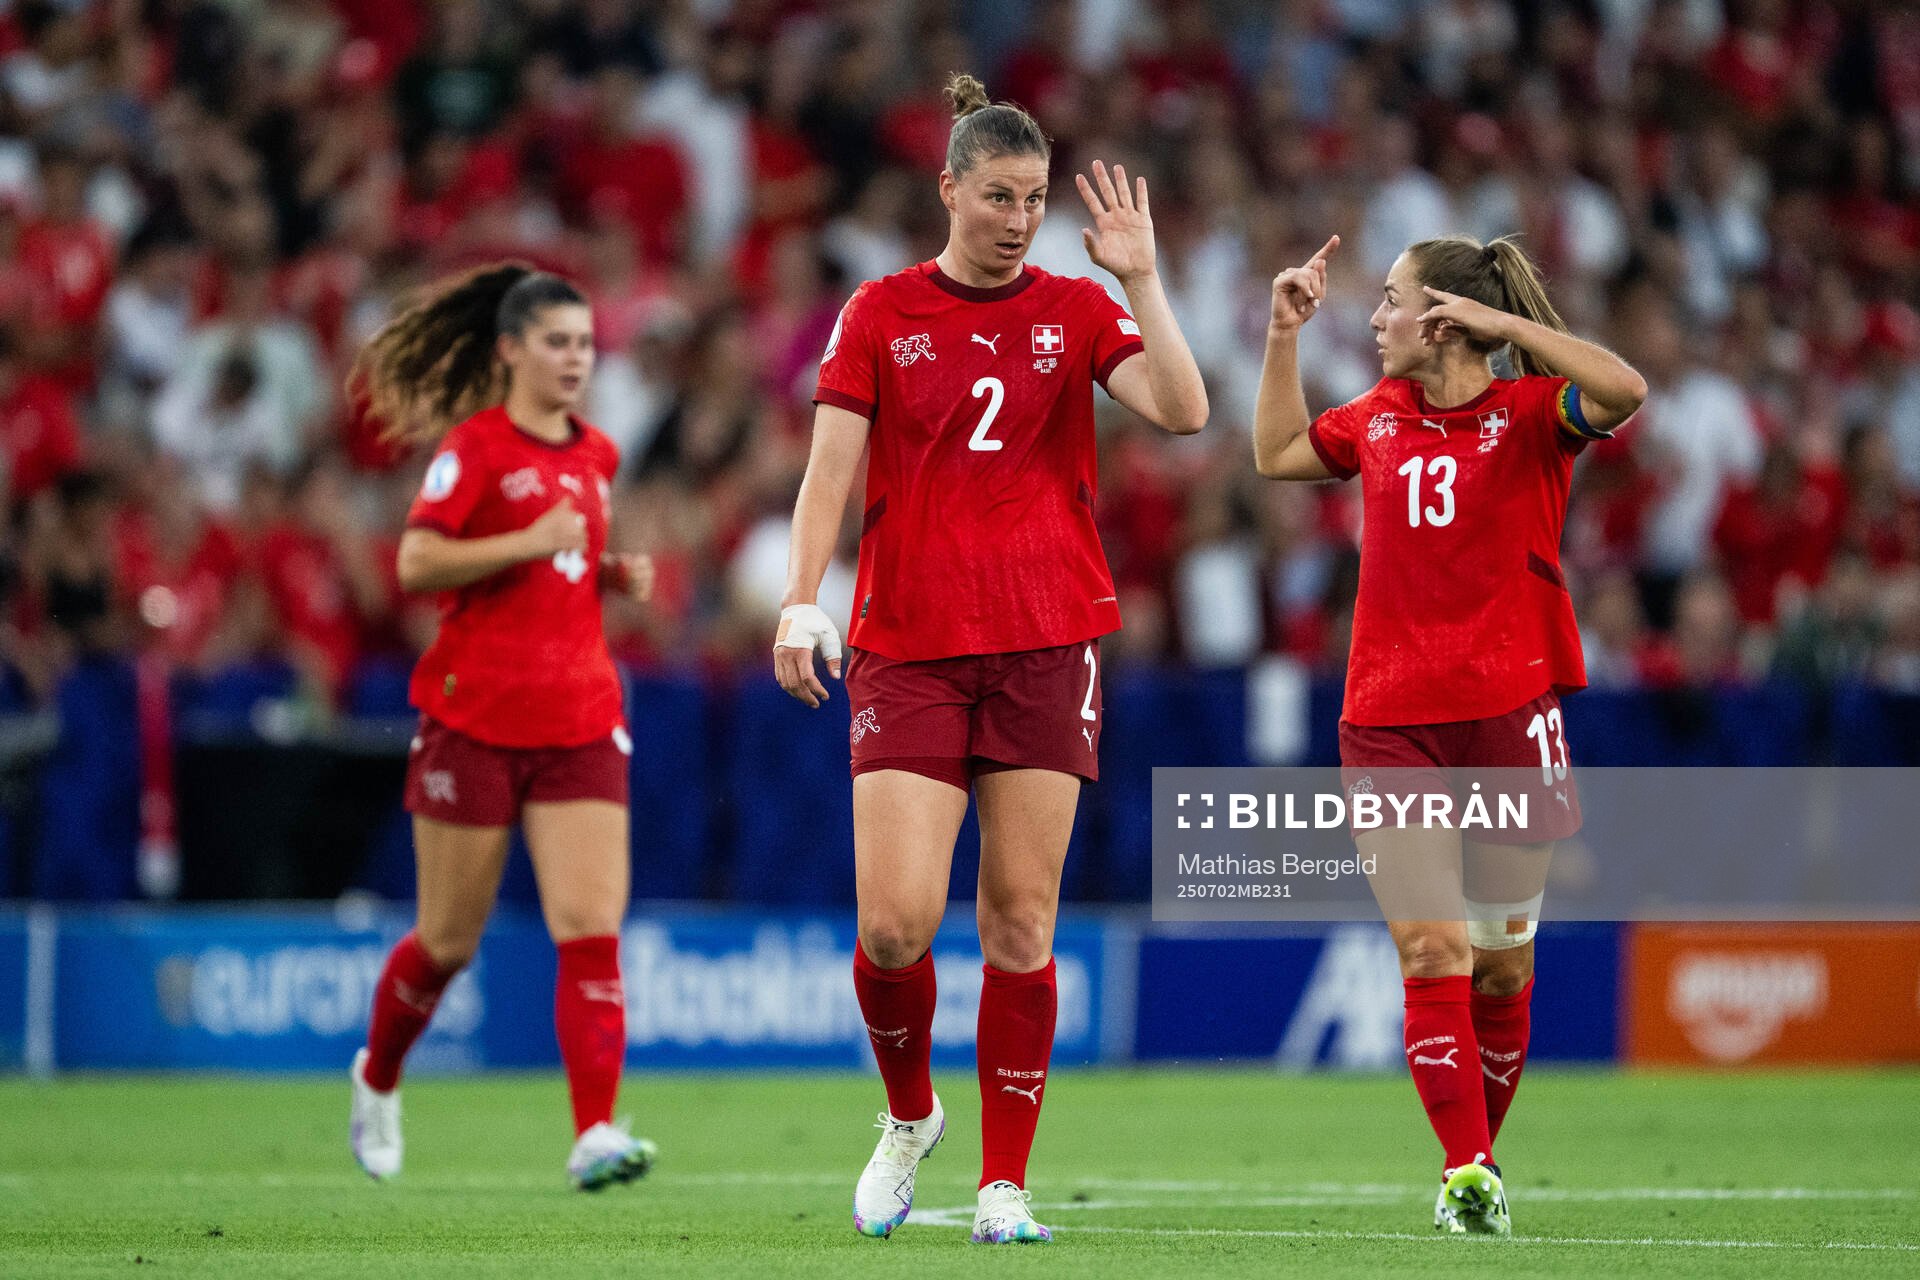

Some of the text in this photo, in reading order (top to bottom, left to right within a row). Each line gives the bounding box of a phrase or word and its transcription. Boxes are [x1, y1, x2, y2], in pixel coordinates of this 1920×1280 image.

[968, 376, 1005, 451] 2
[1398, 455, 1457, 528] 13
[1080, 645, 1097, 721] 2
[1526, 707, 1567, 787] 13
[996, 1067, 1045, 1079] SUISSE
[1480, 1046, 1521, 1062] UISSE
